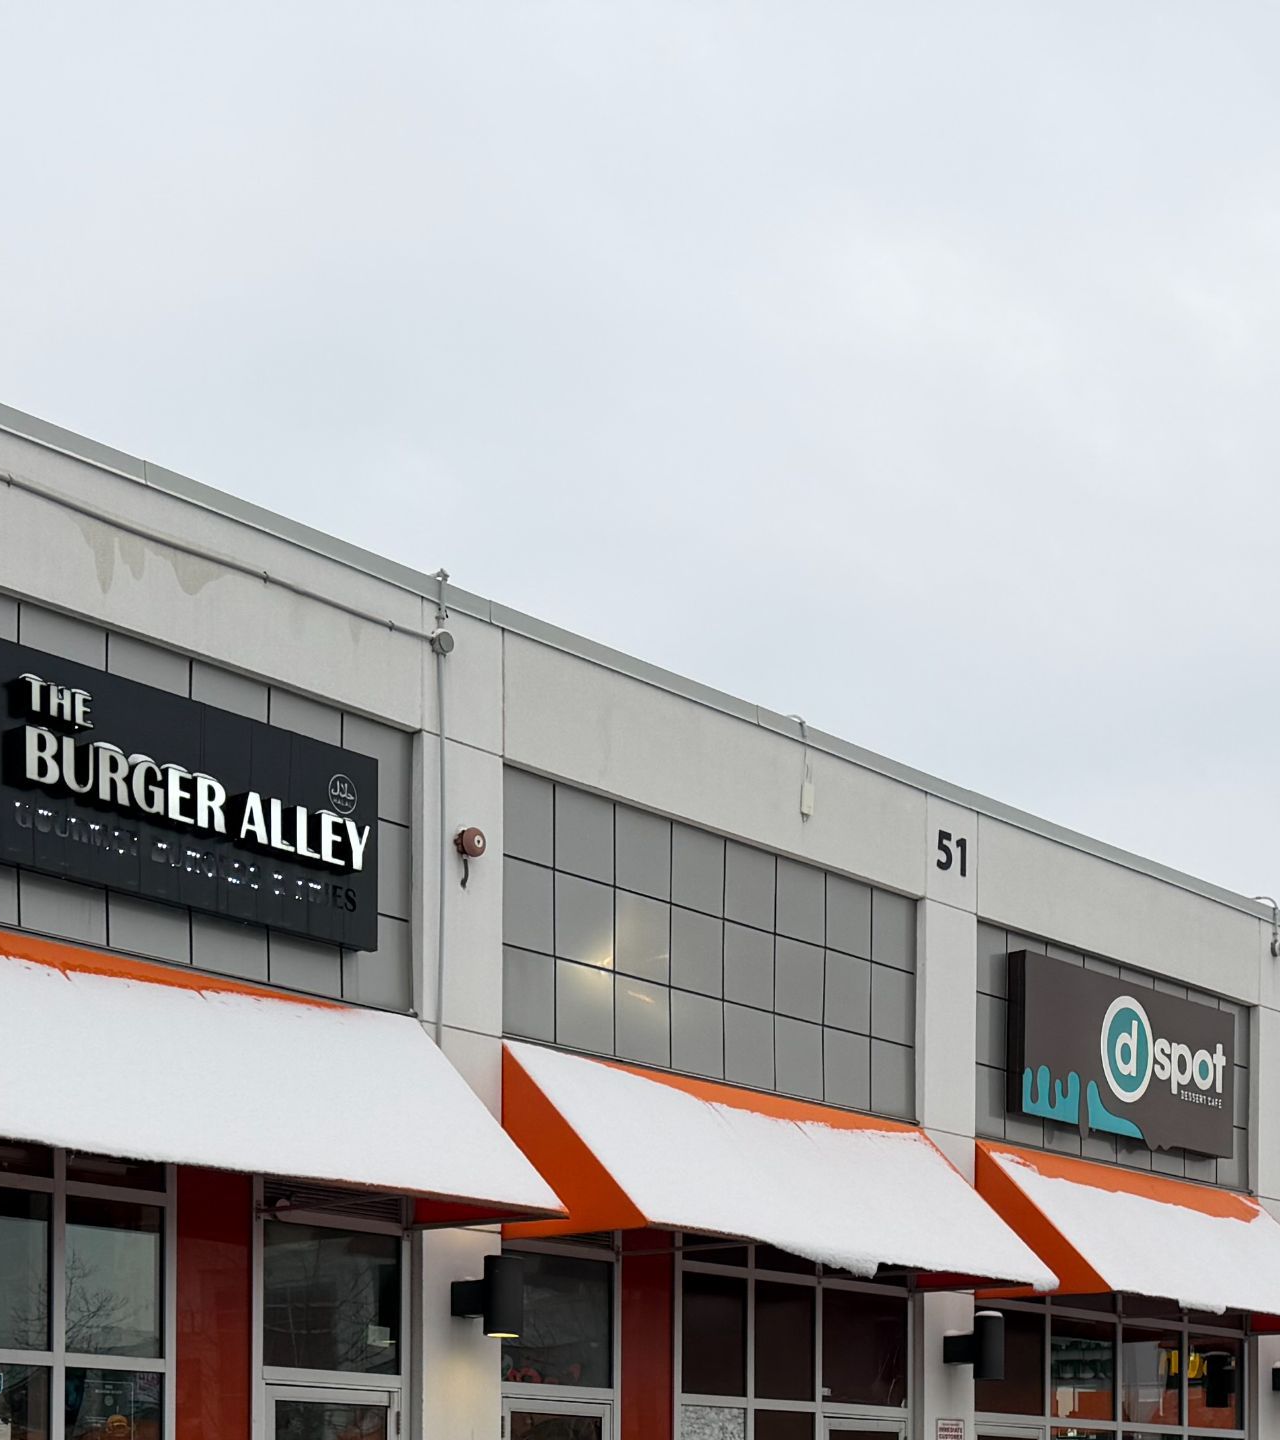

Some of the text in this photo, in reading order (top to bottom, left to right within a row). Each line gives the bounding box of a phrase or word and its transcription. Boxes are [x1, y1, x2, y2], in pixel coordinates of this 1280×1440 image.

[24, 675, 94, 729] THE
[24, 724, 371, 871] BURGER ALLEY
[935, 829, 968, 878] 51
[1153, 1037, 1227, 1095] spot
